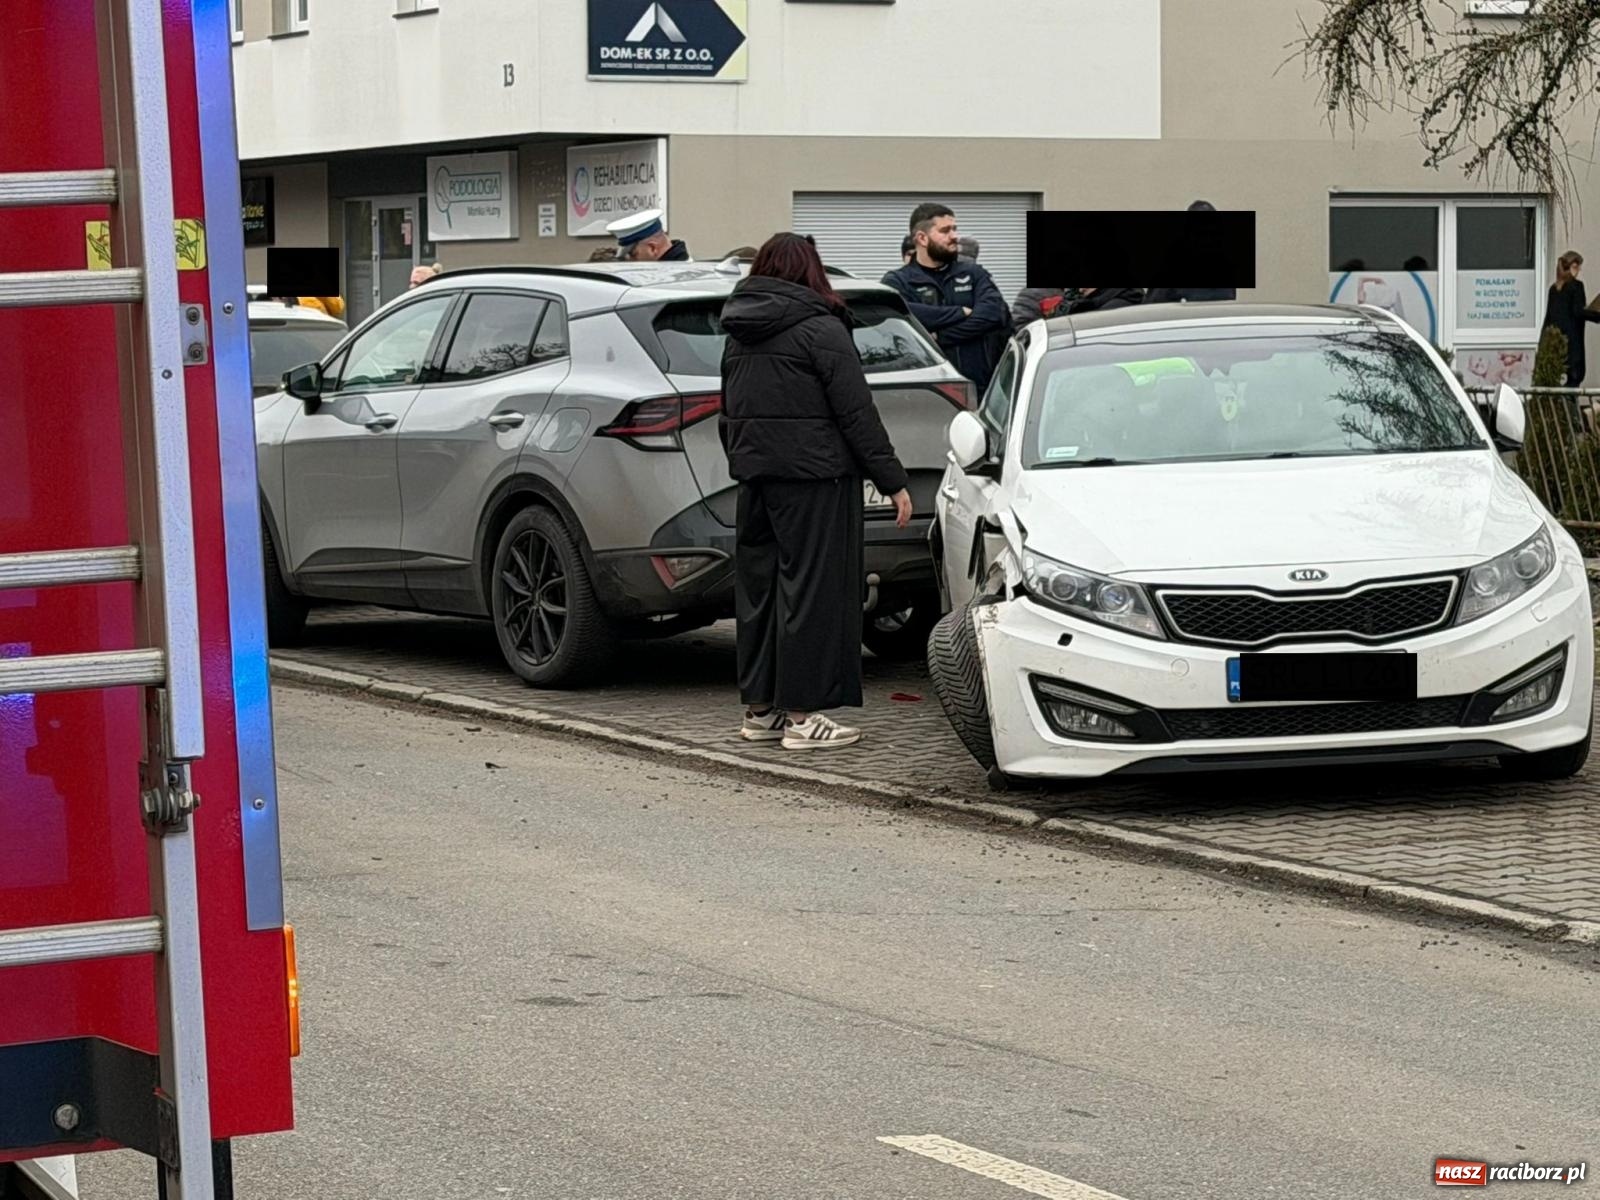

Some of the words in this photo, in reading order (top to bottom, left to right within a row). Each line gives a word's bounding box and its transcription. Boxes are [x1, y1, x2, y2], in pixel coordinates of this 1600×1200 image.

[600, 47, 653, 60] DOM-EK
[673, 49, 683, 60] Z
[685, 48, 714, 61] O.O.
[503, 63, 514, 87] 13
[449, 178, 500, 196] PODOLOGIA
[1295, 570, 1322, 580] KIA
